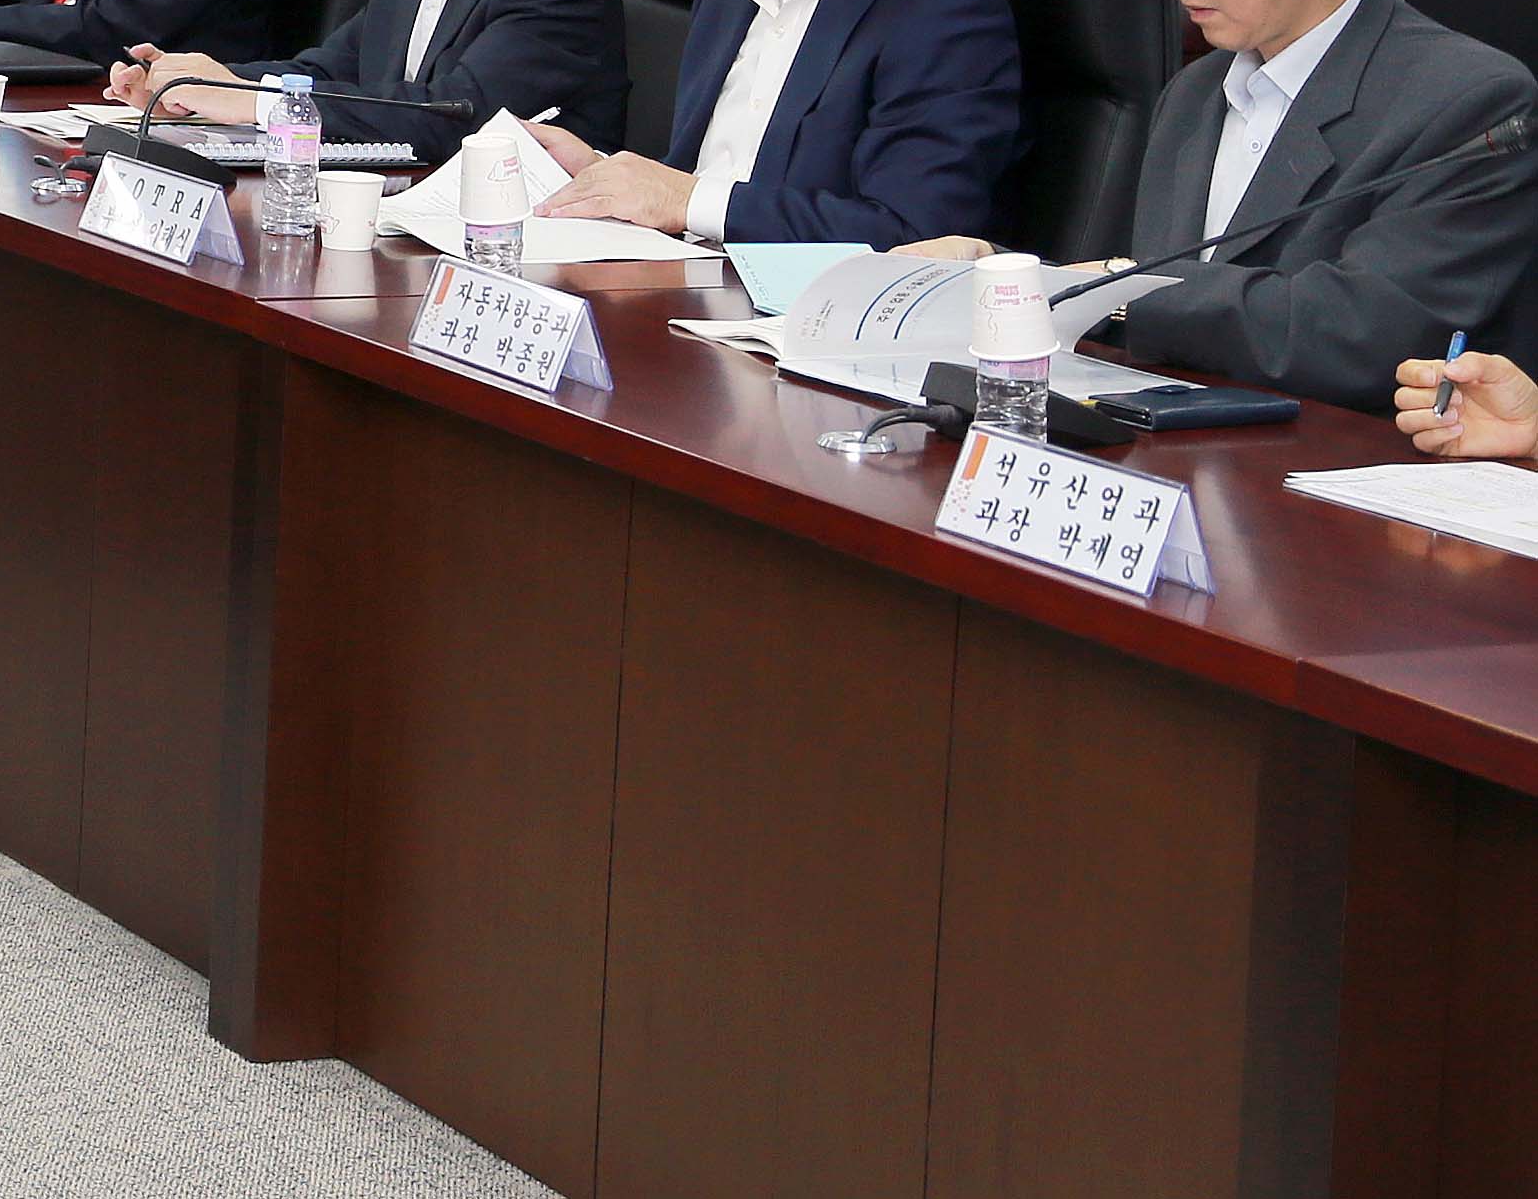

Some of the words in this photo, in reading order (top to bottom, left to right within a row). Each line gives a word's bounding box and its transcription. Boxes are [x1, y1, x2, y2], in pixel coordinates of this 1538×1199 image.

[117, 172, 206, 221] OTRA
[455, 280, 572, 343] 자동차항공과
[440, 317, 479, 355] 과장
[496, 335, 556, 382] 박종원
[974, 498, 1030, 543] 과장
[1058, 522, 1145, 580] 박재영
